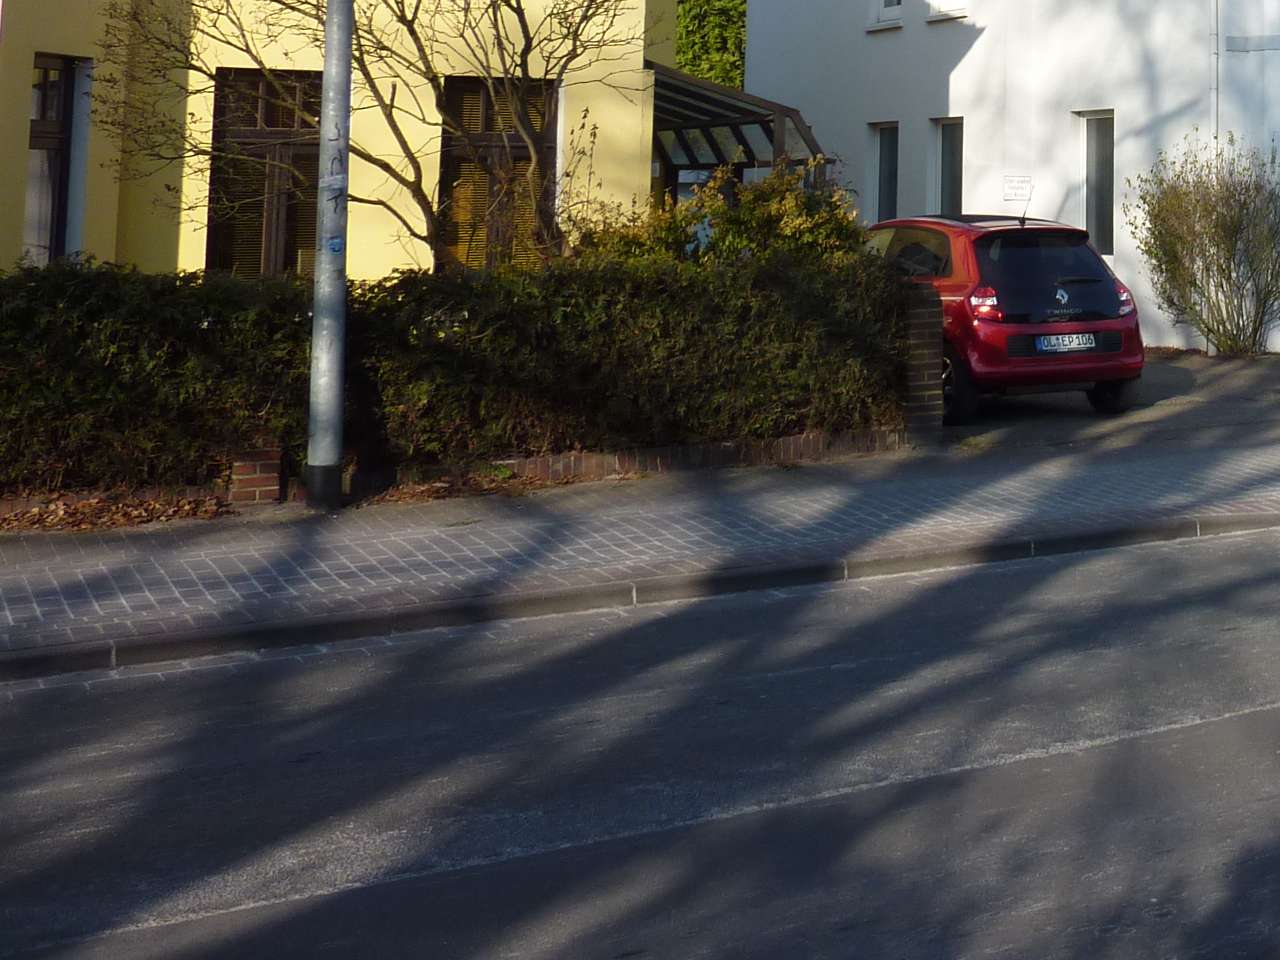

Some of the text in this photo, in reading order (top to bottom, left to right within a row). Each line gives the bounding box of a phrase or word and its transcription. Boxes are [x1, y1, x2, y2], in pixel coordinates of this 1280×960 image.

[1042, 334, 1094, 348] OL EP 106
